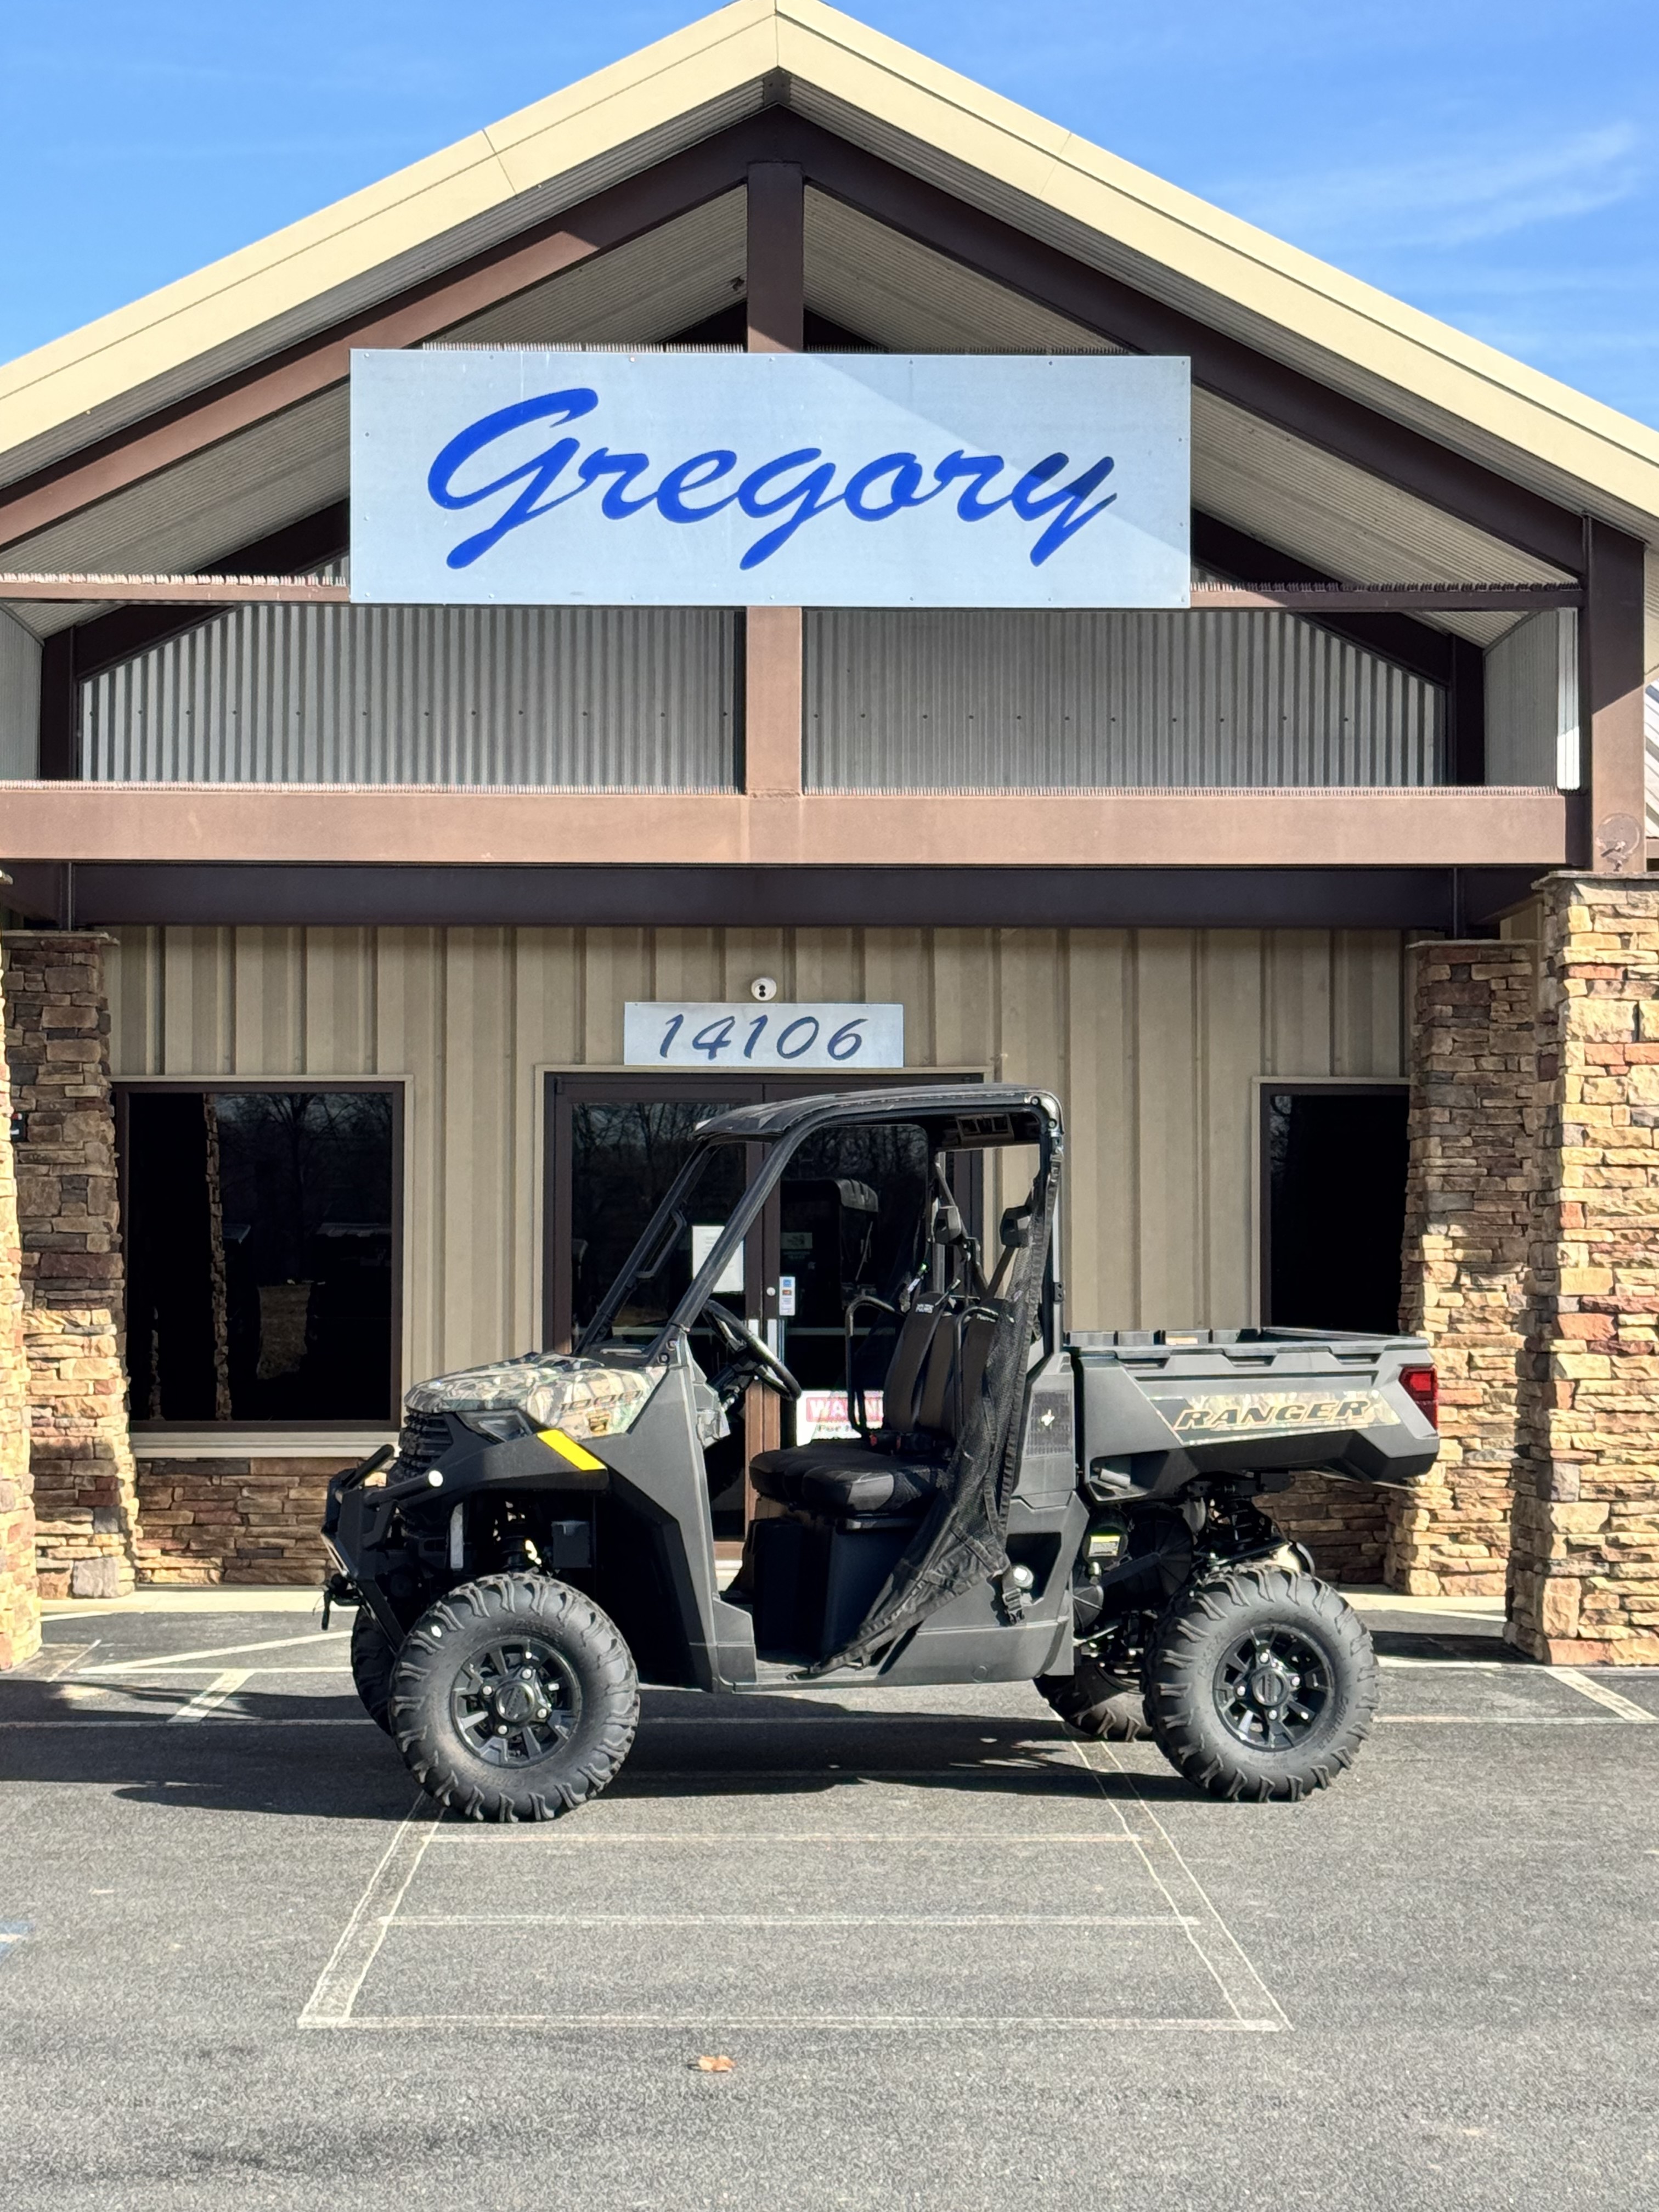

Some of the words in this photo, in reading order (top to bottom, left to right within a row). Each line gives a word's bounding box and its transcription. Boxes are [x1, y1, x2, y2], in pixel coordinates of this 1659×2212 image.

[427, 387, 1117, 571] Gregory
[659, 1014, 868, 1060] 14106
[560, 1390, 644, 1412] 1000
[1175, 1400, 1370, 1430] RANGER
